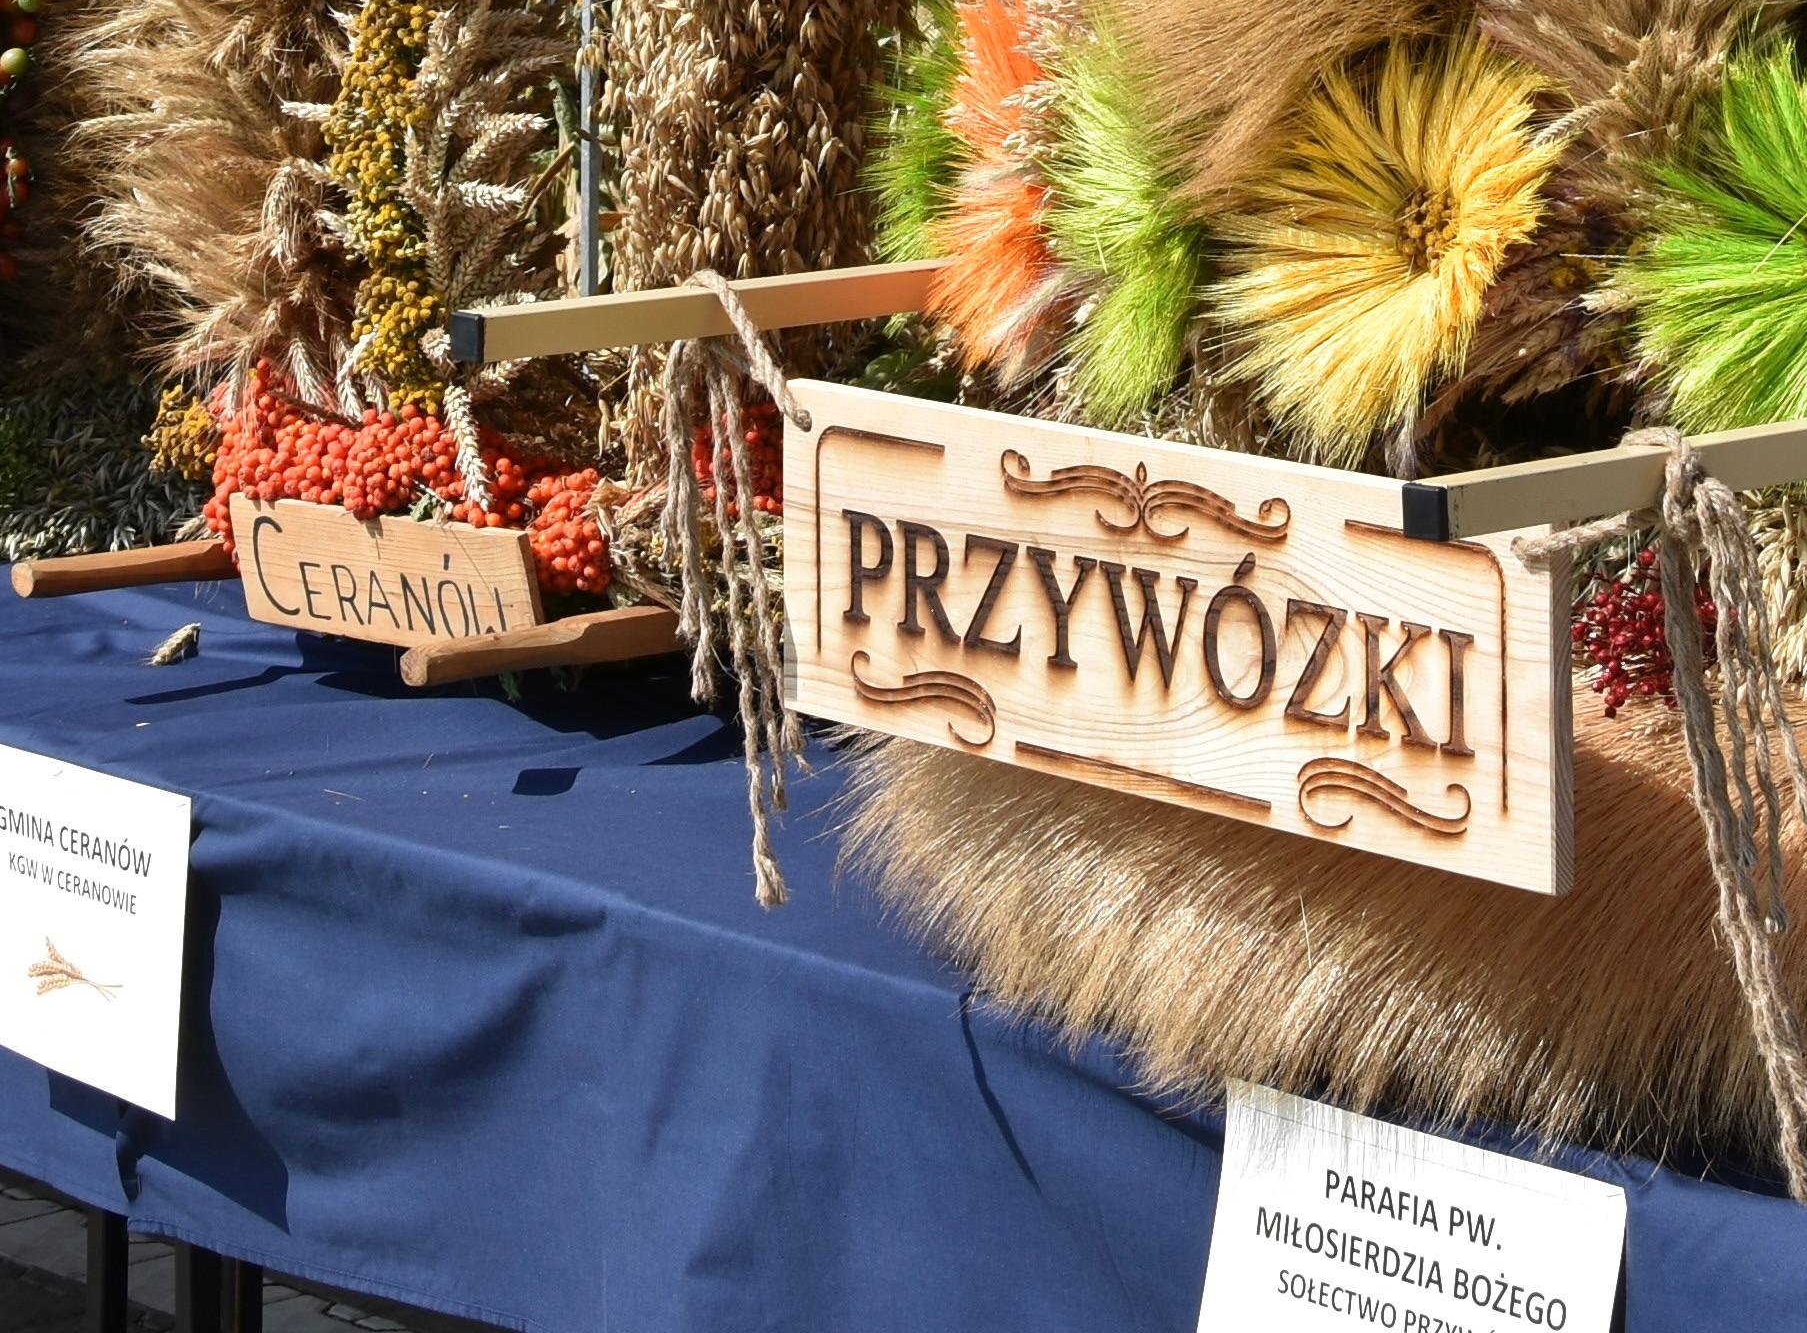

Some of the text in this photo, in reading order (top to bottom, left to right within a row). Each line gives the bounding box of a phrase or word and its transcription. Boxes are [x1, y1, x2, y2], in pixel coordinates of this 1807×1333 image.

[252, 514, 509, 640] CERANÓW
[841, 507, 1476, 757] PRZYWÓZKI
[8, 851, 137, 915] KGW W CERANOWIE
[59, 826, 152, 878] CERANÓW
[1324, 1168, 1503, 1251] PARAFIA PW.
[1255, 1205, 1568, 1332] MIŁOSIERDZIA BOŻEGO
[1277, 1269, 1397, 1329] SOŁECTWO
